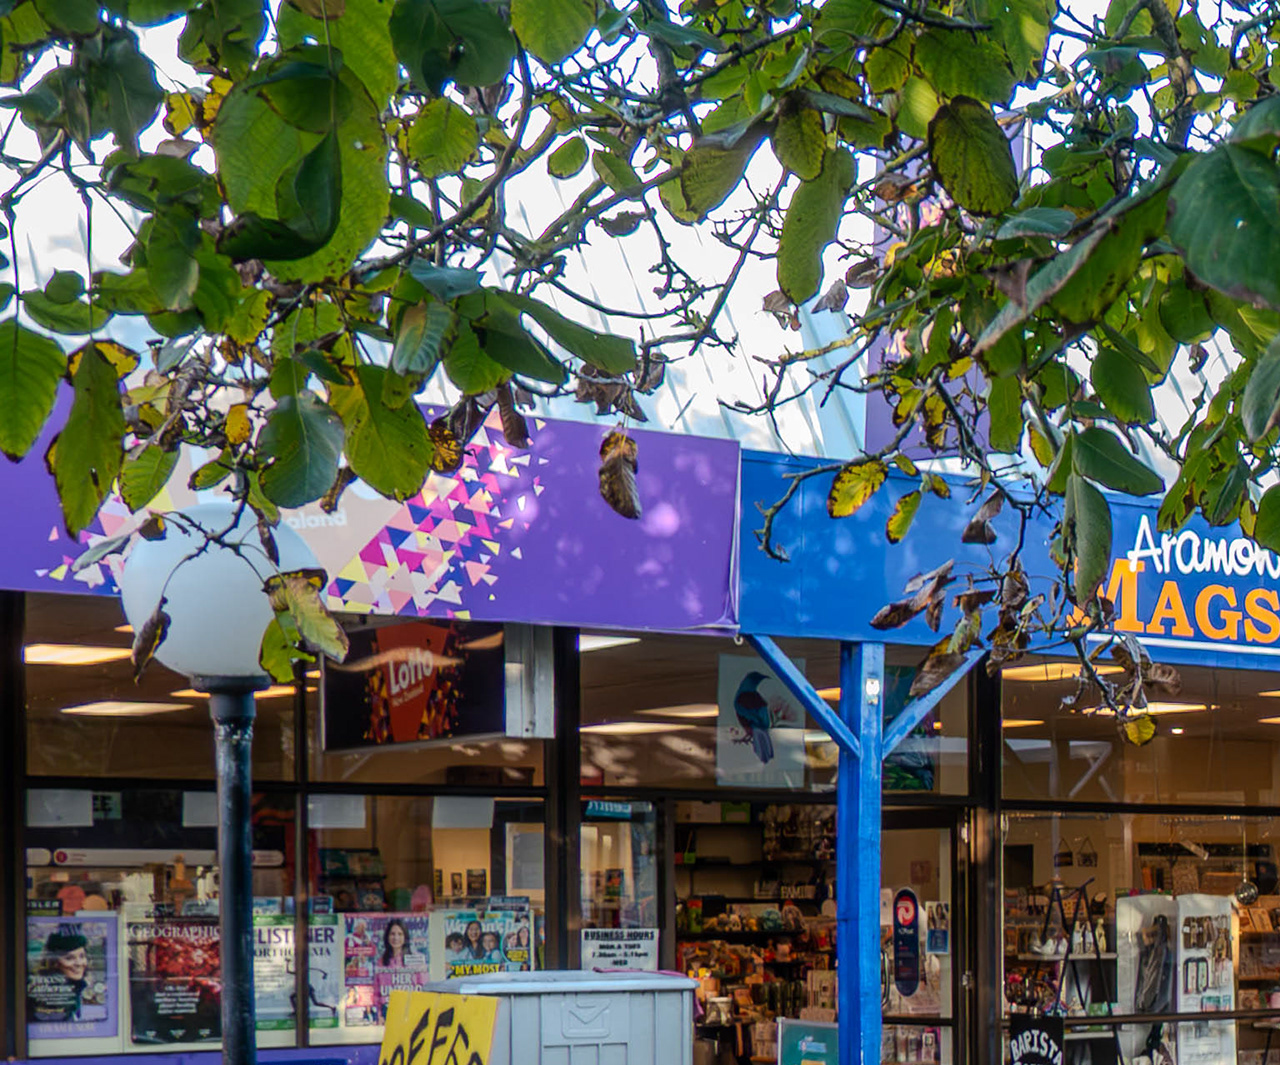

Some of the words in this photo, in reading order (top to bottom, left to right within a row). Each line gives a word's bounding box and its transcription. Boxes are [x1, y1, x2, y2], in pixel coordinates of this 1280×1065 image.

[388, 647, 434, 695] Lotto
[258, 927, 334, 944] LISTER
[584, 931, 624, 941] BUSINESS
[627, 930, 654, 941] HOURS
